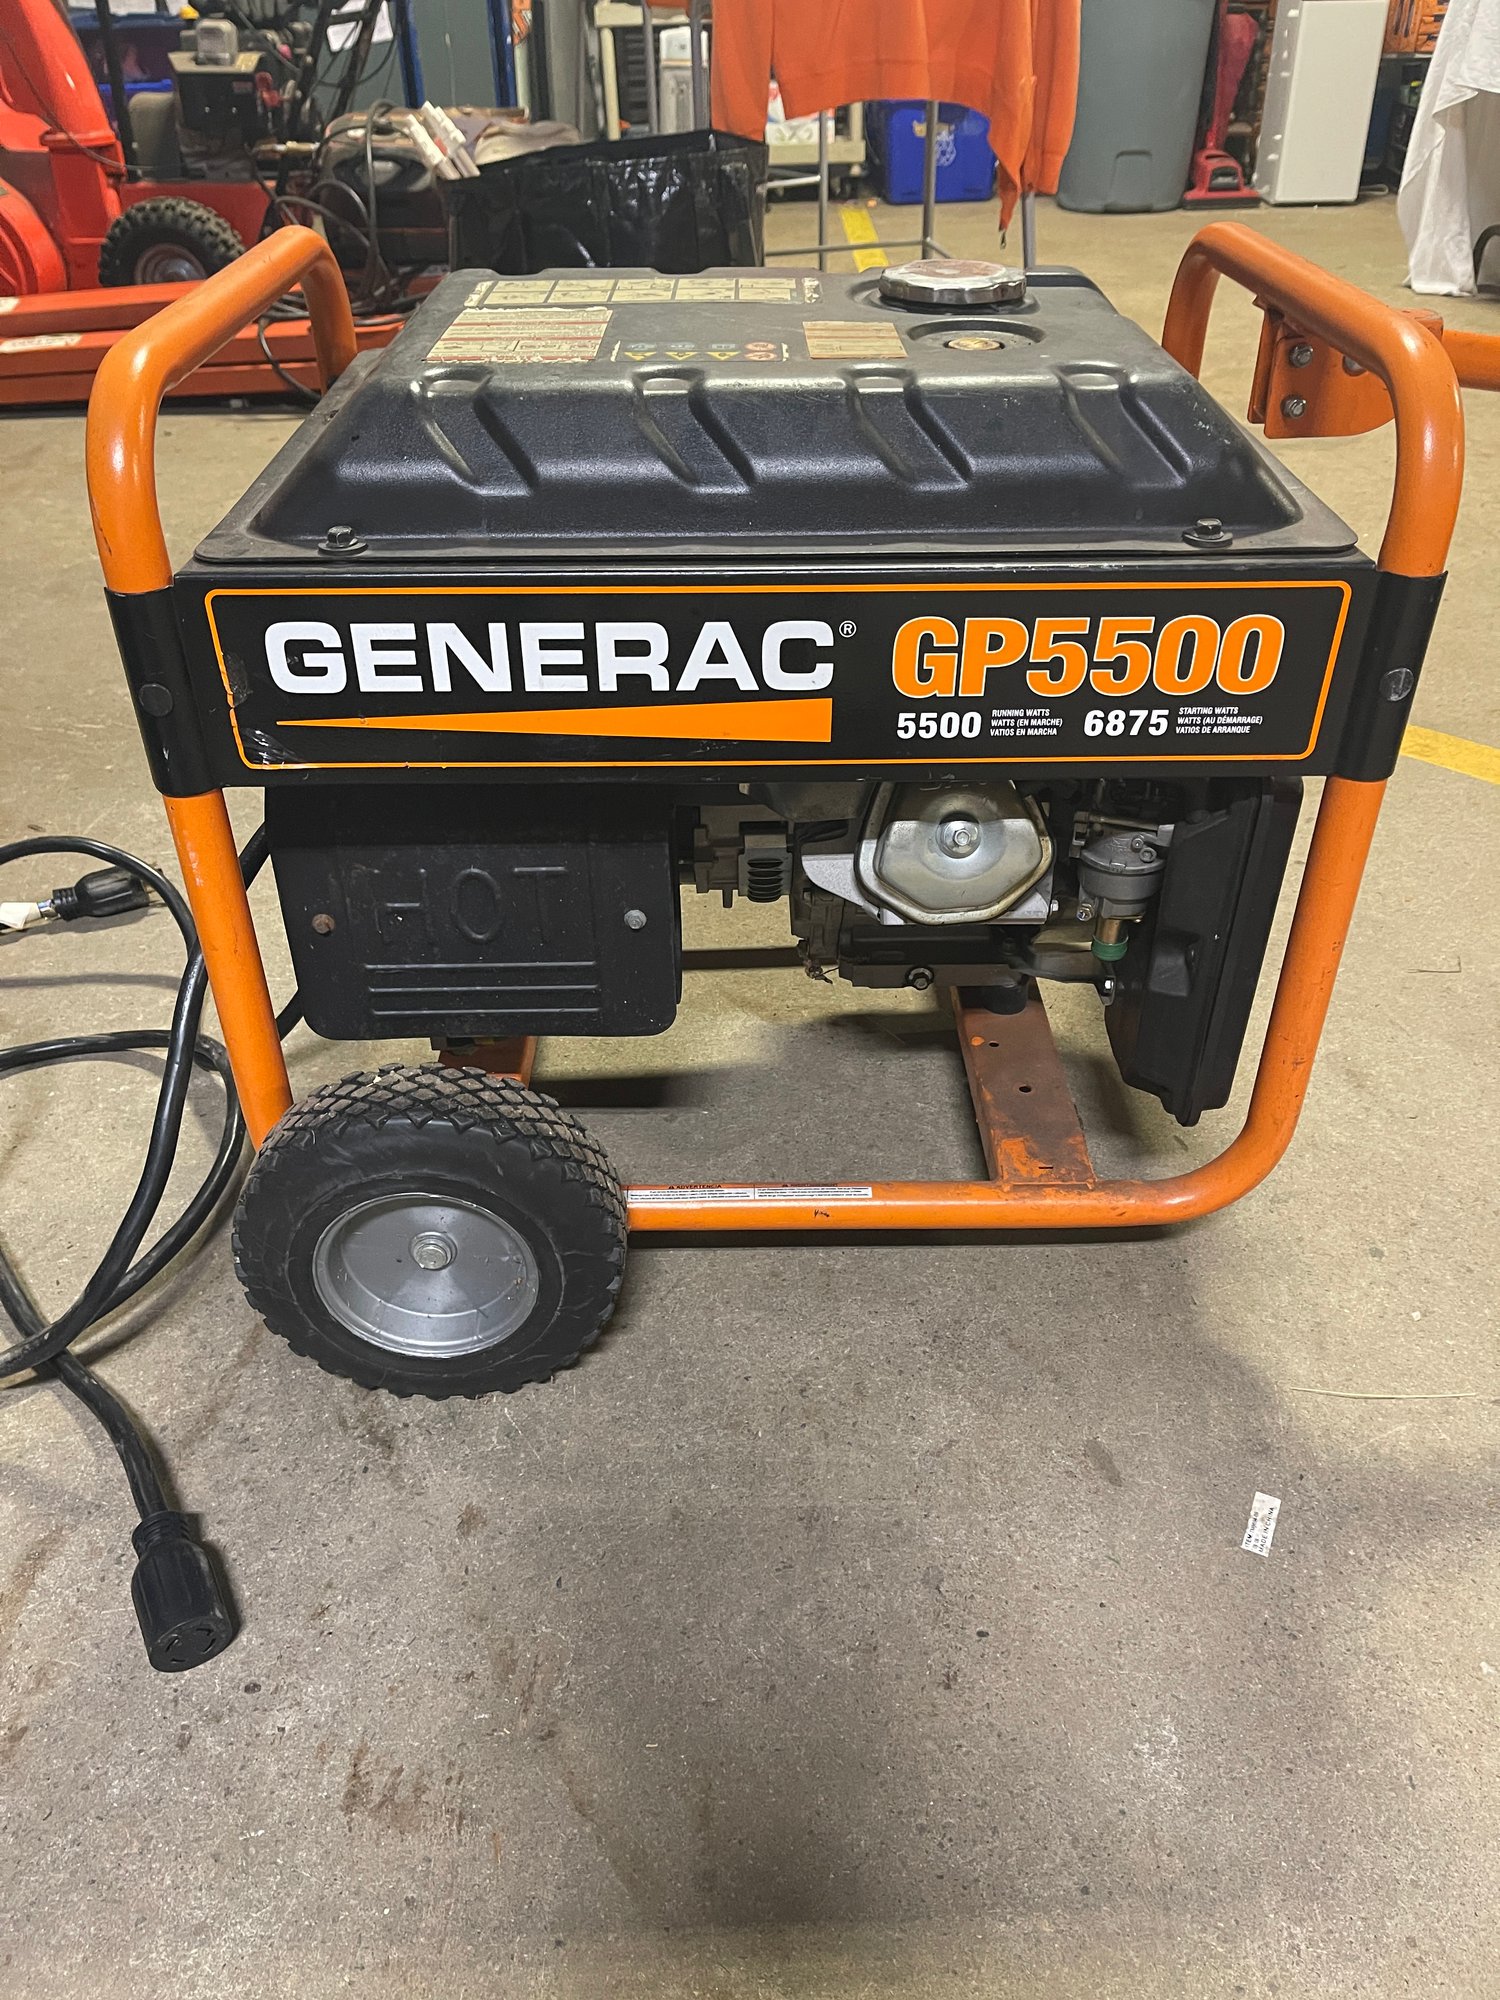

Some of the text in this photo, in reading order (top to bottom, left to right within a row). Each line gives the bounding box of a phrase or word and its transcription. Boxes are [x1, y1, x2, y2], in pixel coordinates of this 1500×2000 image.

[892, 614, 1285, 698] GP5500
[991, 708, 1050, 717] RUNNING WATTS
[1178, 706, 1239, 715] STARTING WATTS
[896, 711, 982, 739] 5500
[991, 718, 1063, 727] WATTS (EN MARCHE)
[1083, 709, 1170, 737] 6875
[1177, 715, 1263, 725] WATTS (AU DÉMARRAGE)
[990, 727, 1057, 736] VATIOS EN MARCHA
[1175, 725, 1251, 734] VATIOS DE ARRANQUE
[370, 864, 568, 944] HOT
[1258, 1535, 1268, 1552] MADE
